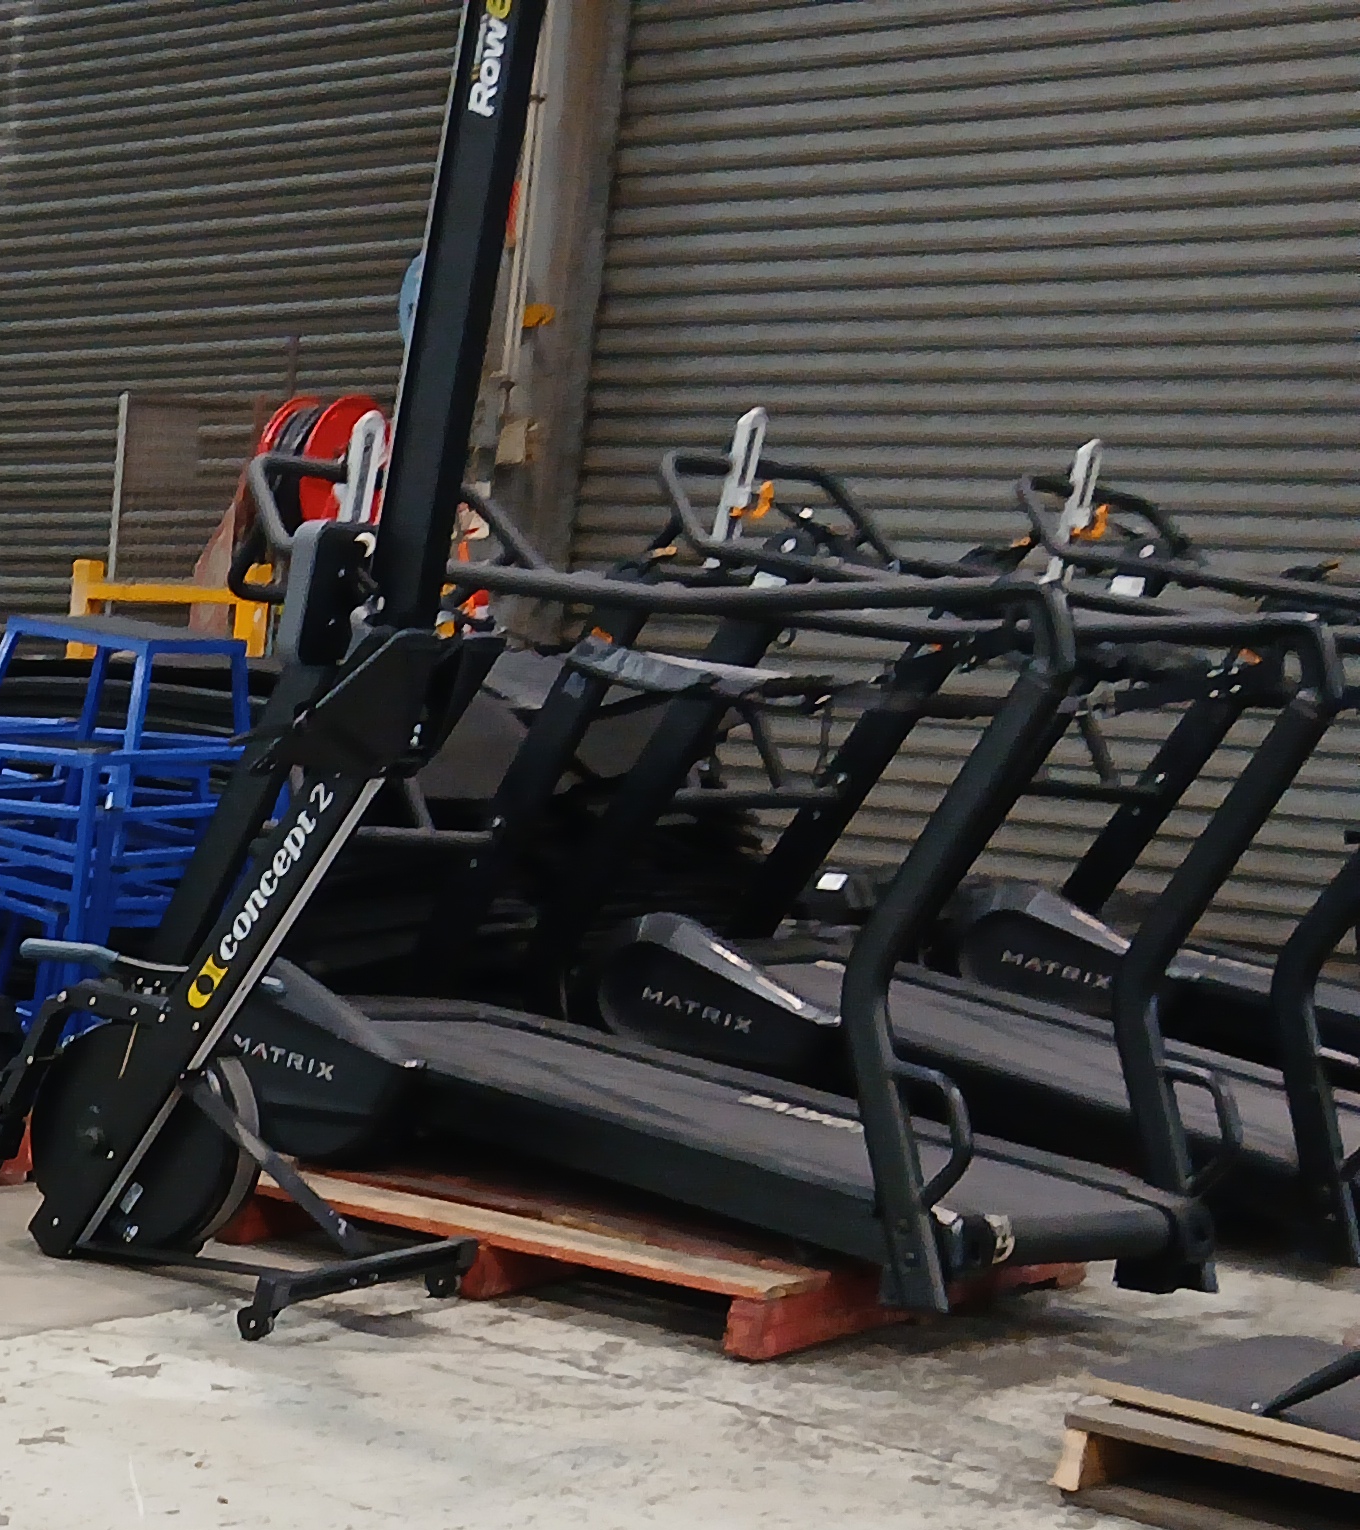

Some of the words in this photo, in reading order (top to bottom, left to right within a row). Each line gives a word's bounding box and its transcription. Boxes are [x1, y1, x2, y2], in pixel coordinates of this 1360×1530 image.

[220, 810, 317, 961] concept
[309, 782, 334, 813] 2
[1001, 949, 1113, 990] MATRIX
[641, 986, 752, 1034] MATRIX
[233, 1033, 334, 1081] MATRIX
